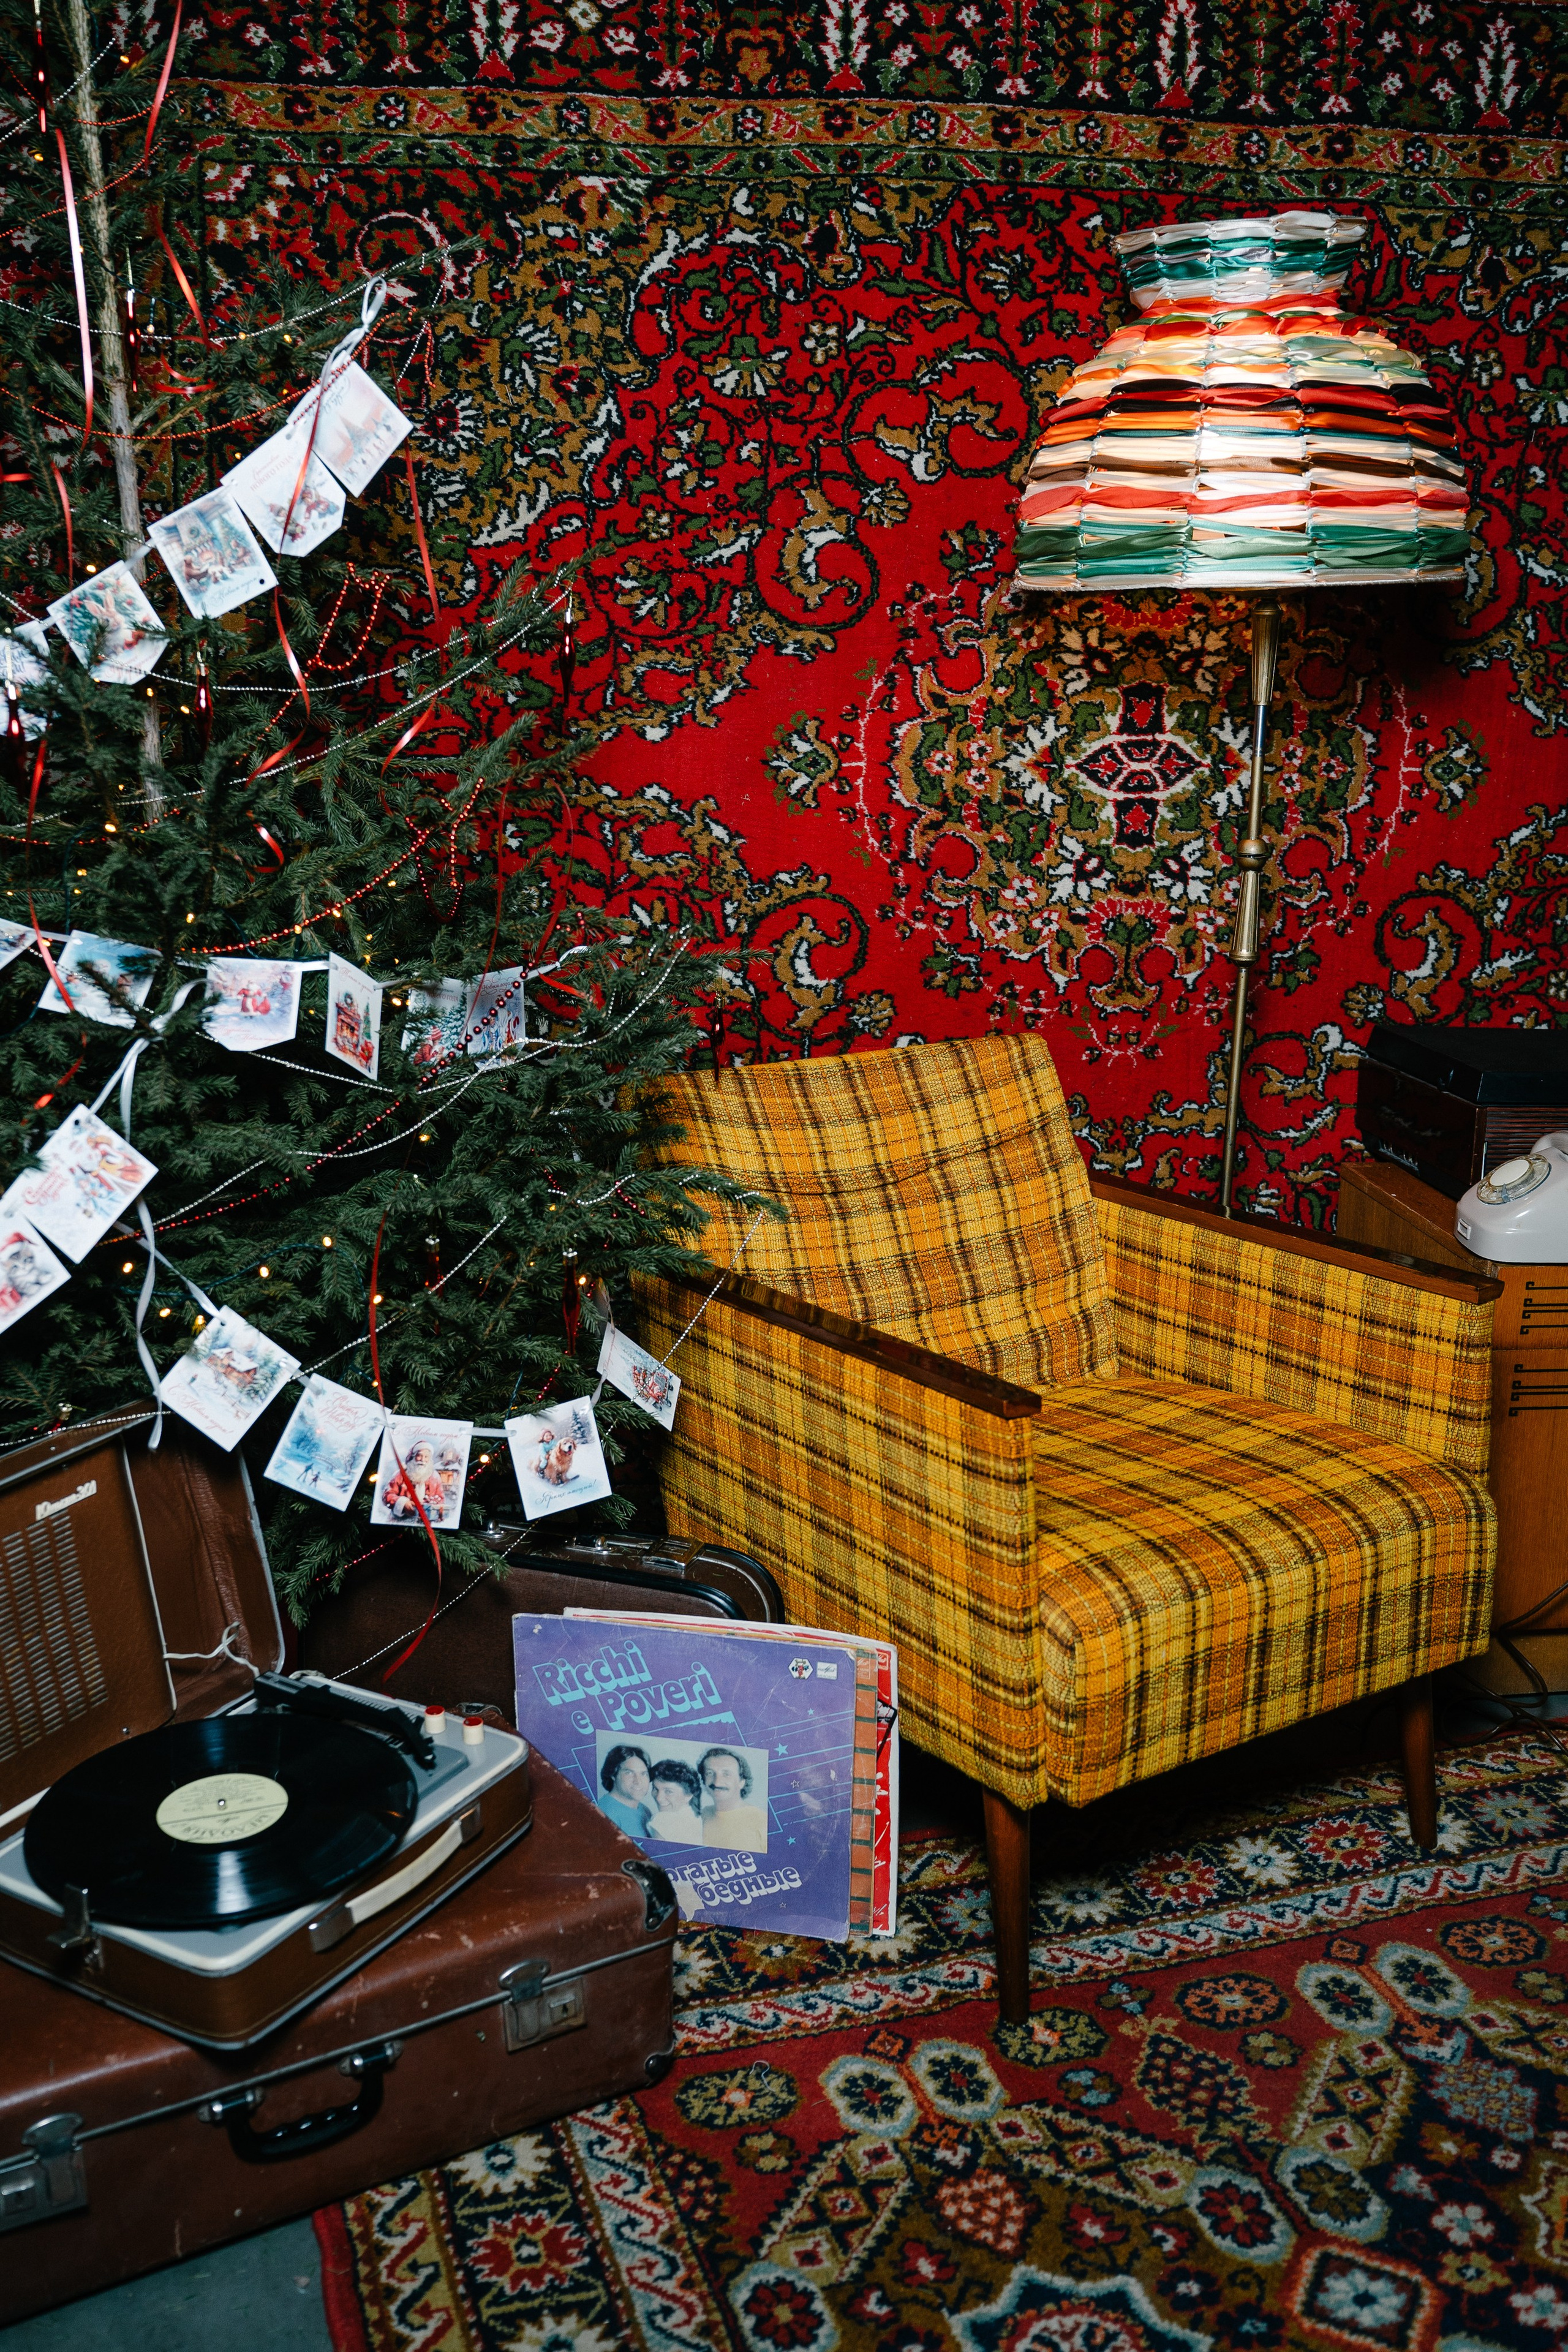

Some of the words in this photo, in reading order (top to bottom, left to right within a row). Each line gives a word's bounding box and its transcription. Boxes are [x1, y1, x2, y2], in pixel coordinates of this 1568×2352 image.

[532, 1640, 652, 1706] Ricchi
[571, 1709, 595, 1735] e
[595, 1661, 723, 1731] Poveri
[664, 1851, 757, 1883] огатые
[697, 1867, 802, 1906] бедные
